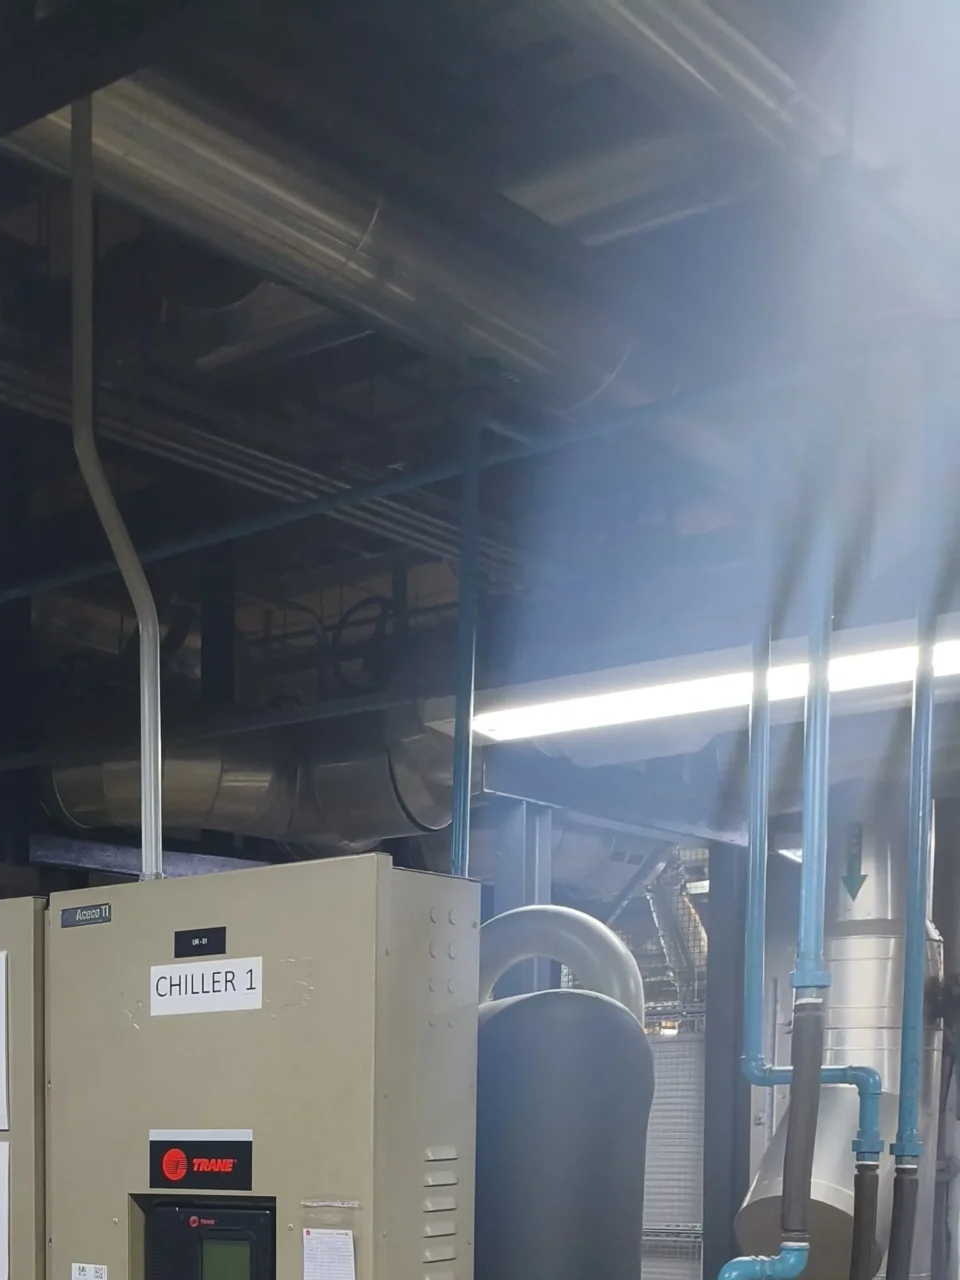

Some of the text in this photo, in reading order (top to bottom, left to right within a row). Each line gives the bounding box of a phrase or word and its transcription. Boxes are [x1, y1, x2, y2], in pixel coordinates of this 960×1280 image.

[76, 908, 100, 921] Aceco
[155, 968, 257, 998] CHILLER 1
[192, 1158, 234, 1172] TRANE
